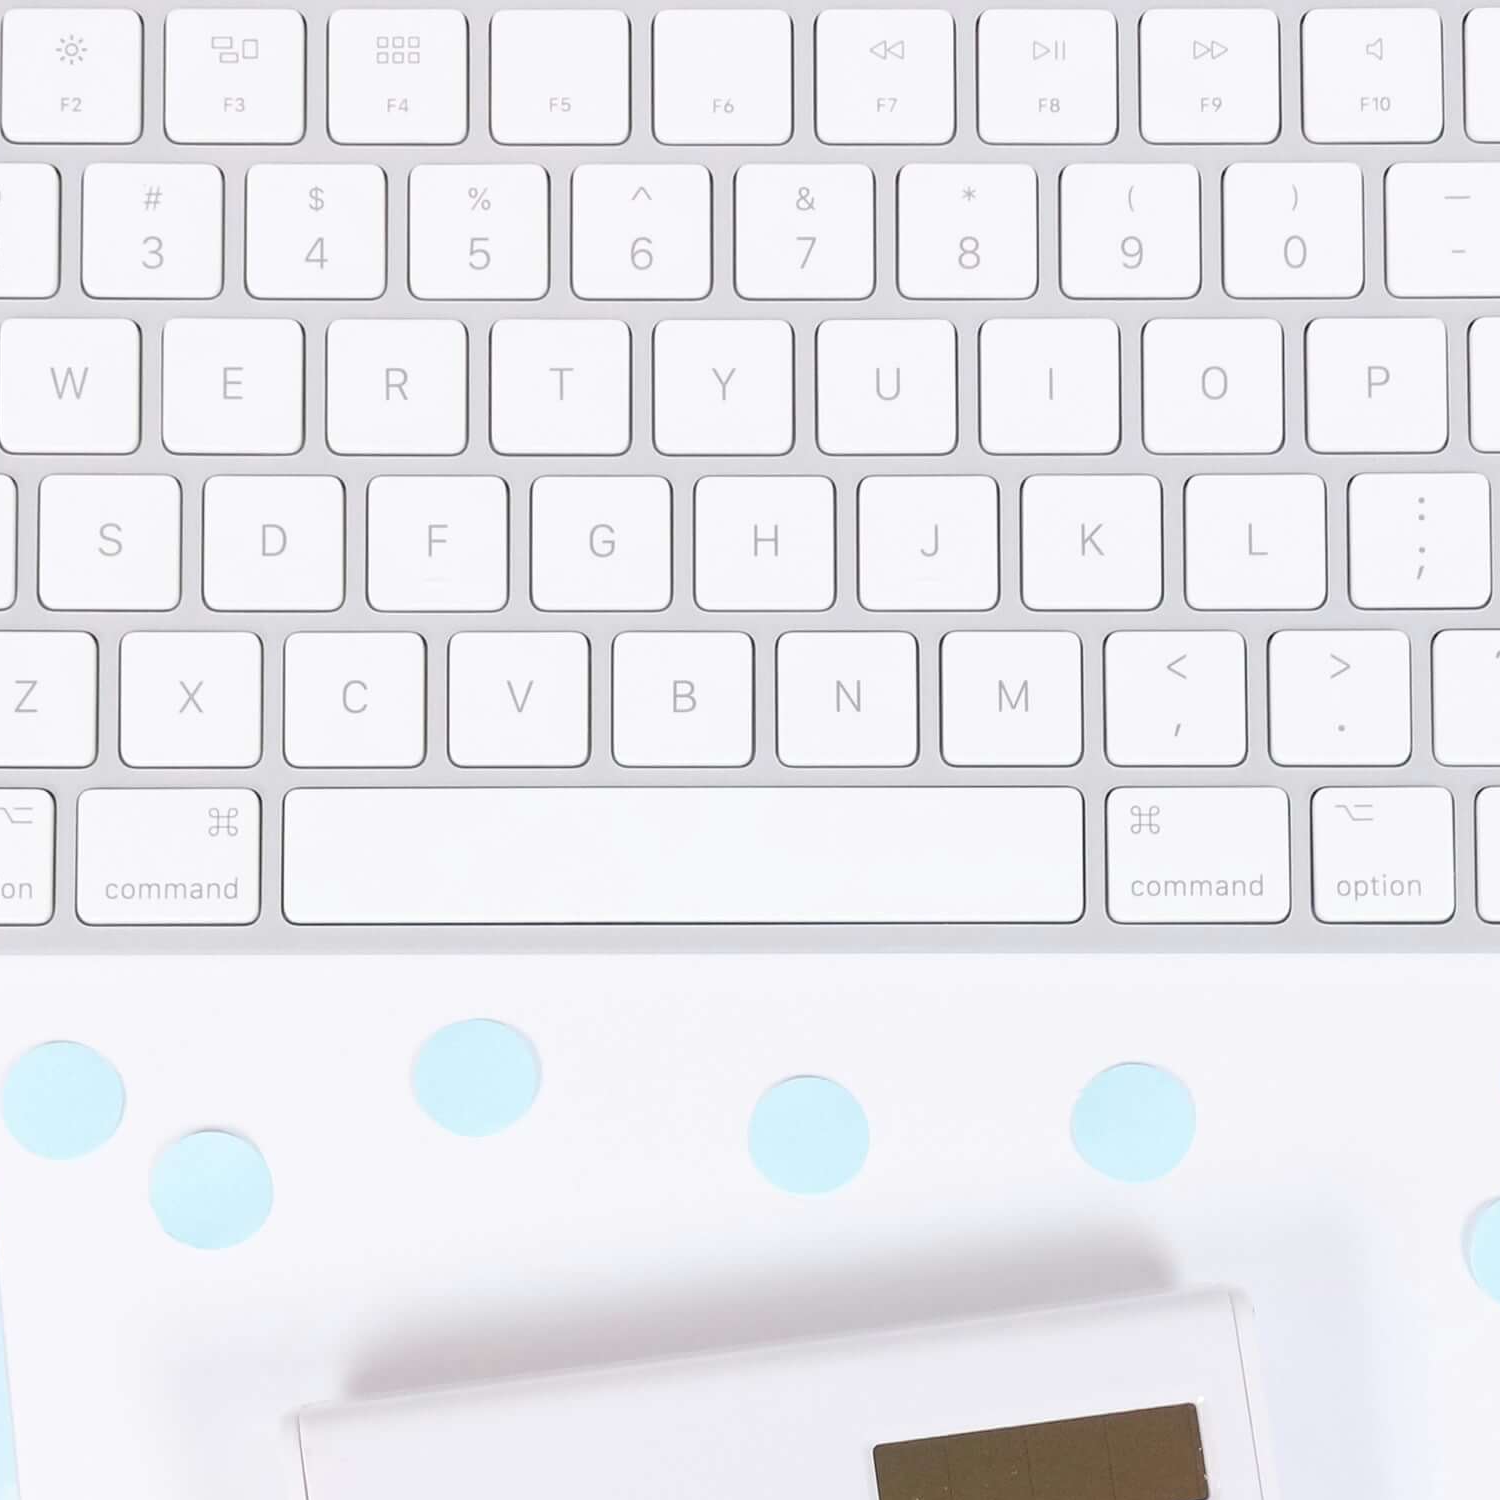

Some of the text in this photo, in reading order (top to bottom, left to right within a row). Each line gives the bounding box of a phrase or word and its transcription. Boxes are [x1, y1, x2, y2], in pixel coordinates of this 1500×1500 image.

[60, 96, 82, 113] F2
[223, 96, 246, 113] F3
[386, 98, 409, 113] F4
[548, 96, 572, 113] F5
[712, 98, 735, 114] F6
[876, 97, 898, 113] F7
[1038, 97, 1061, 113] F8
[1200, 96, 1223, 113] F9
[1360, 96, 1391, 113] F10
[143, 186, 163, 211] #
[308, 185, 325, 213] $
[467, 187, 492, 211] %
[795, 186, 816, 212] &
[141, 235, 165, 270] 3
[304, 236, 329, 270] 4
[468, 236, 491, 271] 5
[630, 236, 654, 271] 6
[795, 236, 817, 270] 7
[957, 235, 981, 270] 8
[1120, 235, 1144, 270] 9
[1283, 234, 1308, 269] 0
[49, 366, 89, 401] W
[222, 366, 244, 400] E
[385, 367, 409, 401] R
[548, 367, 575, 401] T
[711, 367, 737, 401] Y
[875, 367, 901, 401] U
[1201, 365, 1228, 401] O
[1367, 365, 1391, 399] P
[98, 522, 123, 557] S
[261, 523, 288, 557] D
[427, 523, 449, 558] F
[589, 523, 616, 558] G
[753, 523, 779, 557] H
[920, 523, 939, 558] J
[1080, 523, 1105, 557] K
[1247, 522, 1269, 556] L
[14, 679, 39, 713] Z
[179, 680, 204, 714] X
[342, 679, 368, 715] C
[506, 679, 534, 713] V
[672, 679, 697, 713] B
[835, 679, 861, 713] N
[998, 679, 1029, 713] M
[105, 876, 239, 900] command
[1131, 873, 1264, 897] command
[1336, 876, 1422, 902] option
